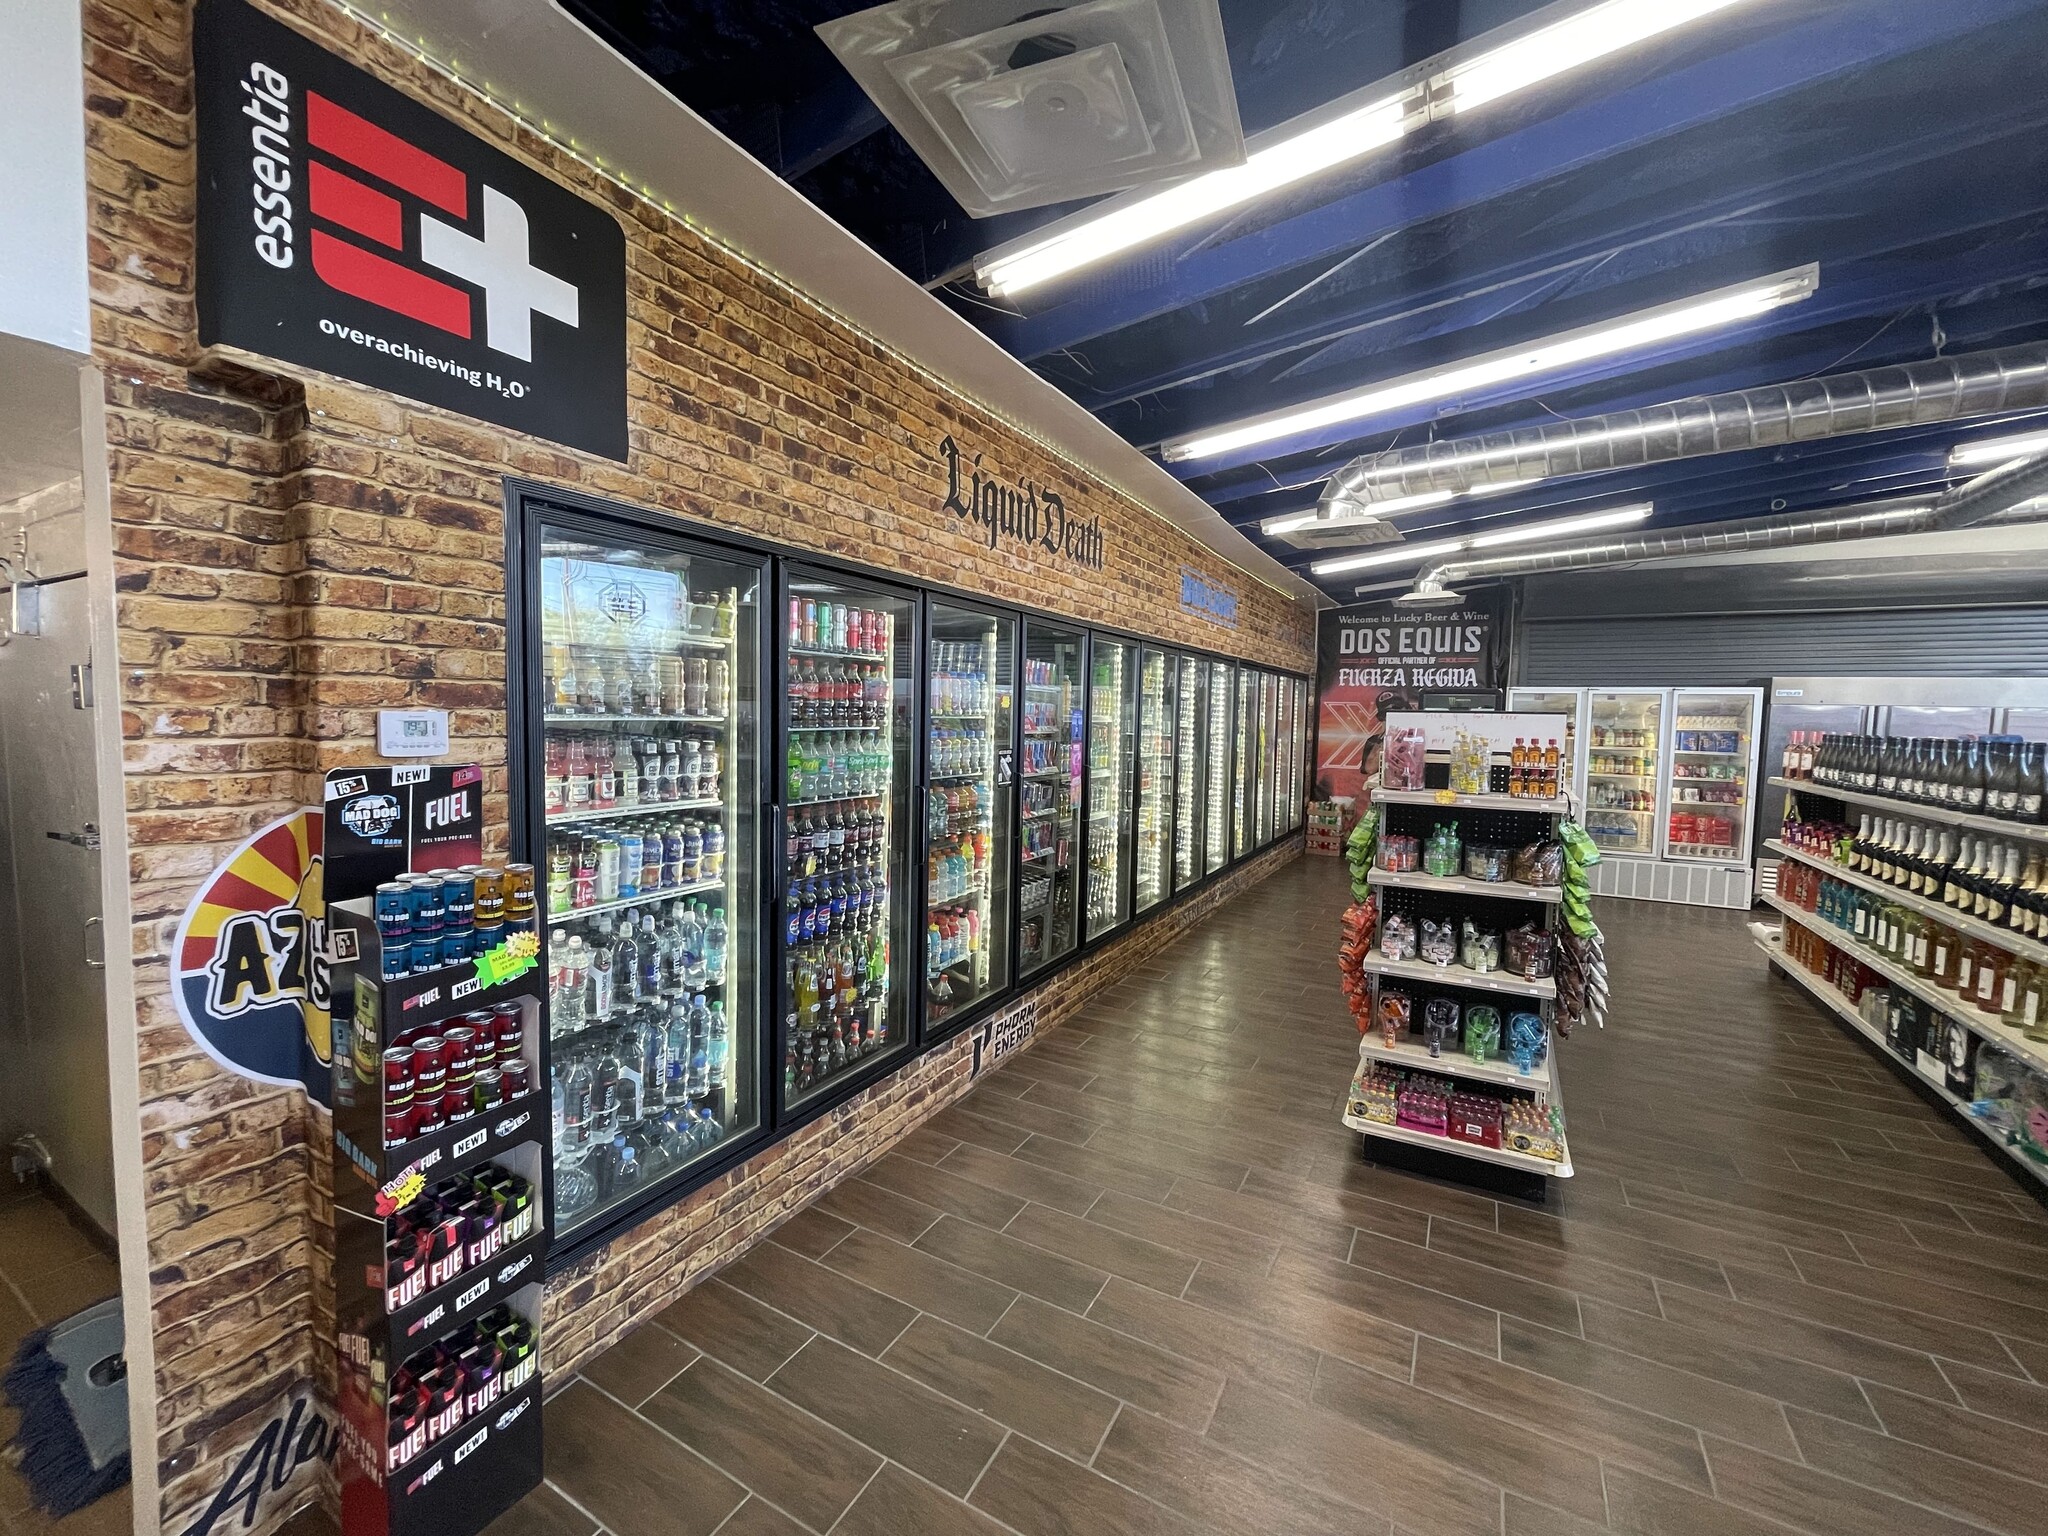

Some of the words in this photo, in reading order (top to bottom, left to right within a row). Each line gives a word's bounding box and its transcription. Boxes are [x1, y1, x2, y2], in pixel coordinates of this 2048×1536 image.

[241, 62, 293, 268] essentia
[318, 318, 482, 387] overachieving
[940, 434, 1038, 550] Liquid
[1039, 487, 1104, 571] Death
[1338, 615, 1379, 624] Welcome
[1381, 615, 1391, 623] to
[1393, 614, 1422, 624] Lucky
[1425, 613, 1448, 622] Beer
[1450, 612, 1460, 620] &
[1463, 611, 1490, 620] Wine
[1340, 627, 1391, 654] DOS
[1399, 626, 1482, 654] EQUIS
[1338, 668, 1406, 687] FUERZA
[1411, 668, 1478, 687] REGIDA
[1378, 657, 1402, 665] OFFICIAL
[1402, 657, 1428, 665] PARTNER
[1429, 656, 1437, 665] OF
[336, 780, 357, 796] 15%
[396, 768, 426, 784] NEW!
[344, 807, 371, 822] MAD
[372, 806, 398, 819] DOG
[425, 790, 472, 830] FUEL
[214, 909, 306, 1010] AZ
[419, 986, 441, 1008] FUEL
[456, 977, 482, 996] NEW!
[994, 1017, 1036, 1059] ENERGY
[995, 1002, 1035, 1040] PHORM
[352, 1144, 378, 1178] BARK
[421, 1148, 443, 1172] FUEL
[457, 1132, 485, 1156] NEW!
[383, 1166, 413, 1193] HOT!
[503, 1203, 533, 1244] FUE
[423, 1304, 445, 1329] FUEL
[460, 1281, 488, 1306] NEW!
[422, 1458, 444, 1485] FUEL
[458, 1429, 487, 1458] NEW!
